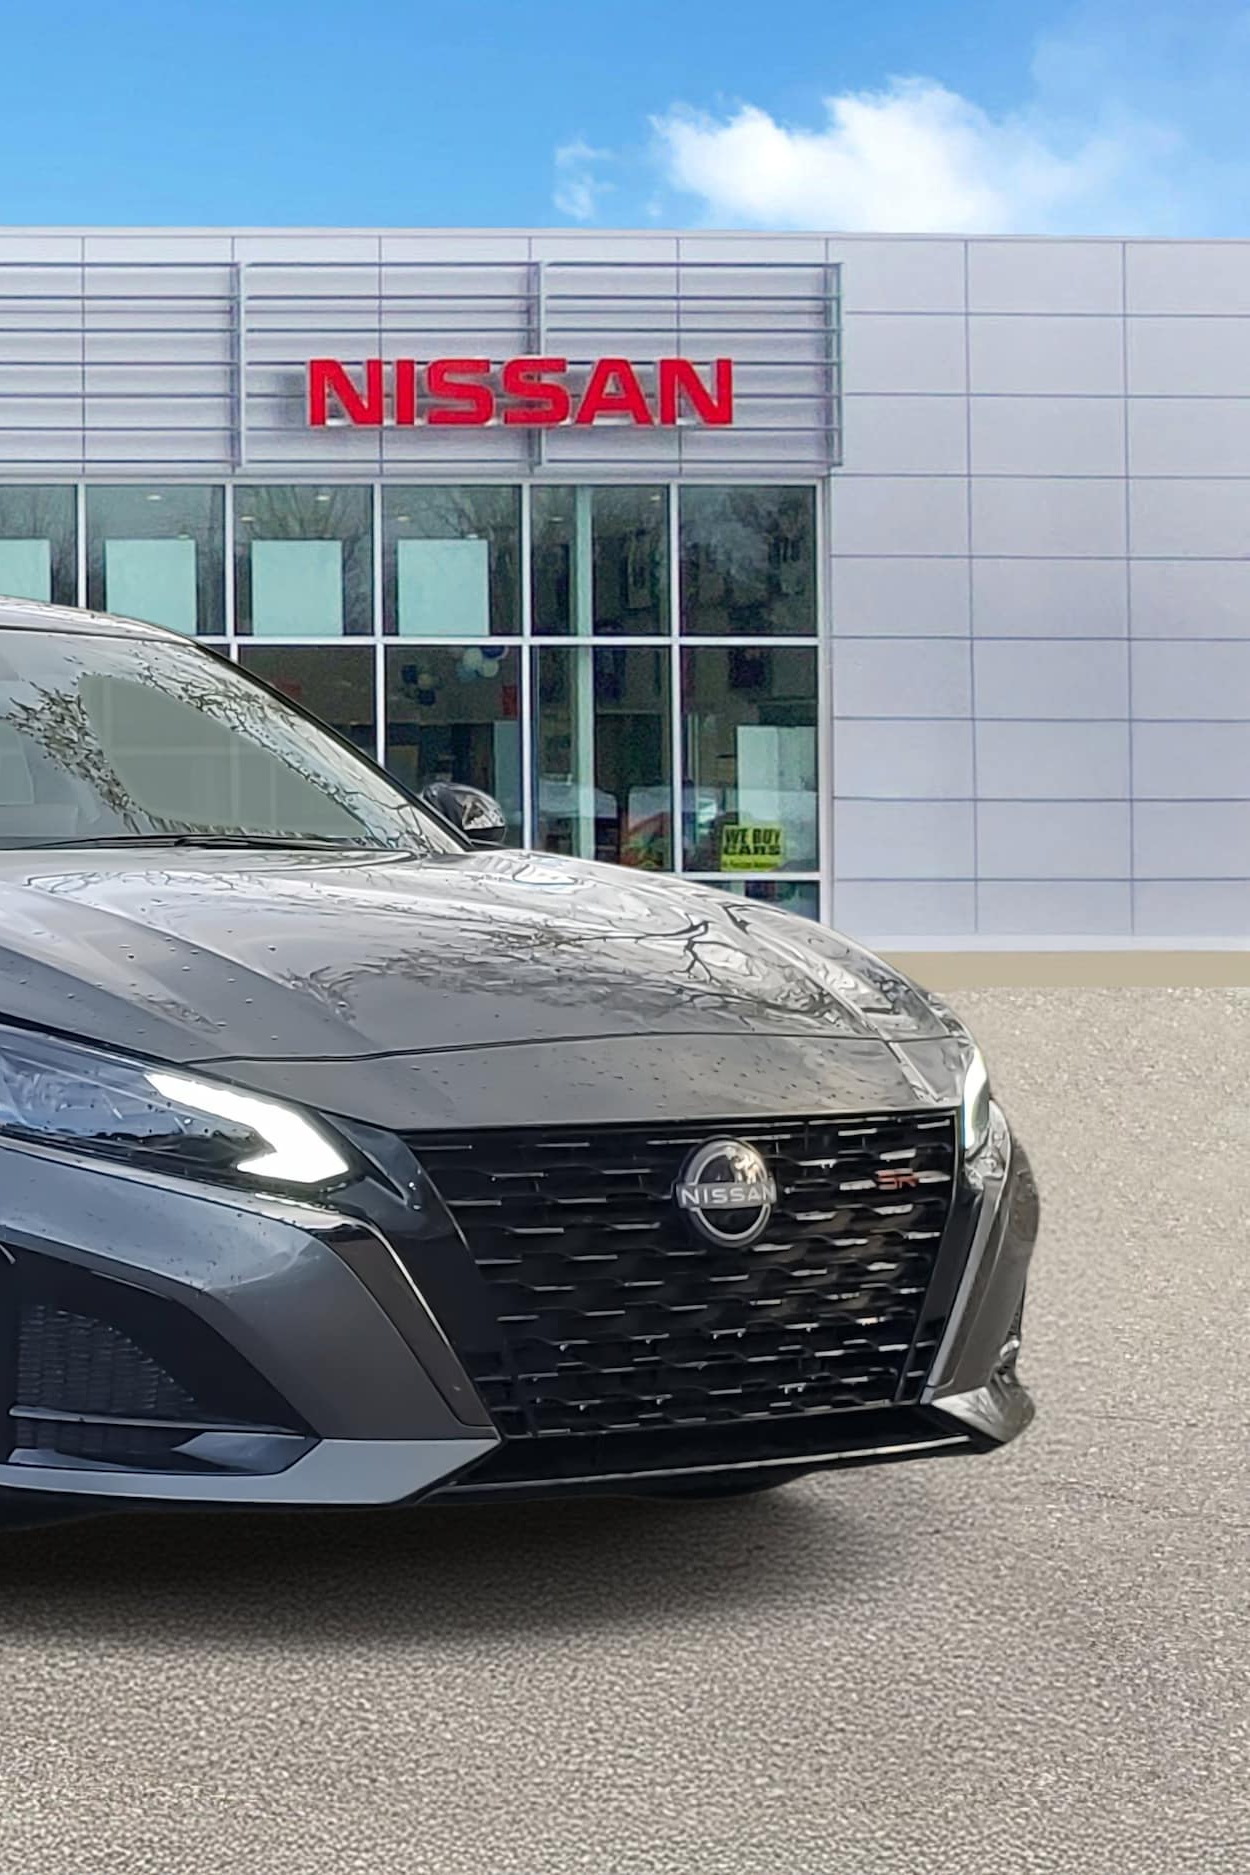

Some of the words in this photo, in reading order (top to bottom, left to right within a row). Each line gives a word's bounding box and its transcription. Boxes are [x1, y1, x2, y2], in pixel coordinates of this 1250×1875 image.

[308, 356, 733, 427] NISSAN
[725, 828, 748, 846] WE
[753, 828, 781, 845] BUY
[724, 845, 781, 856] CARS
[874, 1167, 920, 1191] SR
[680, 1182, 776, 1206] NISSAN
